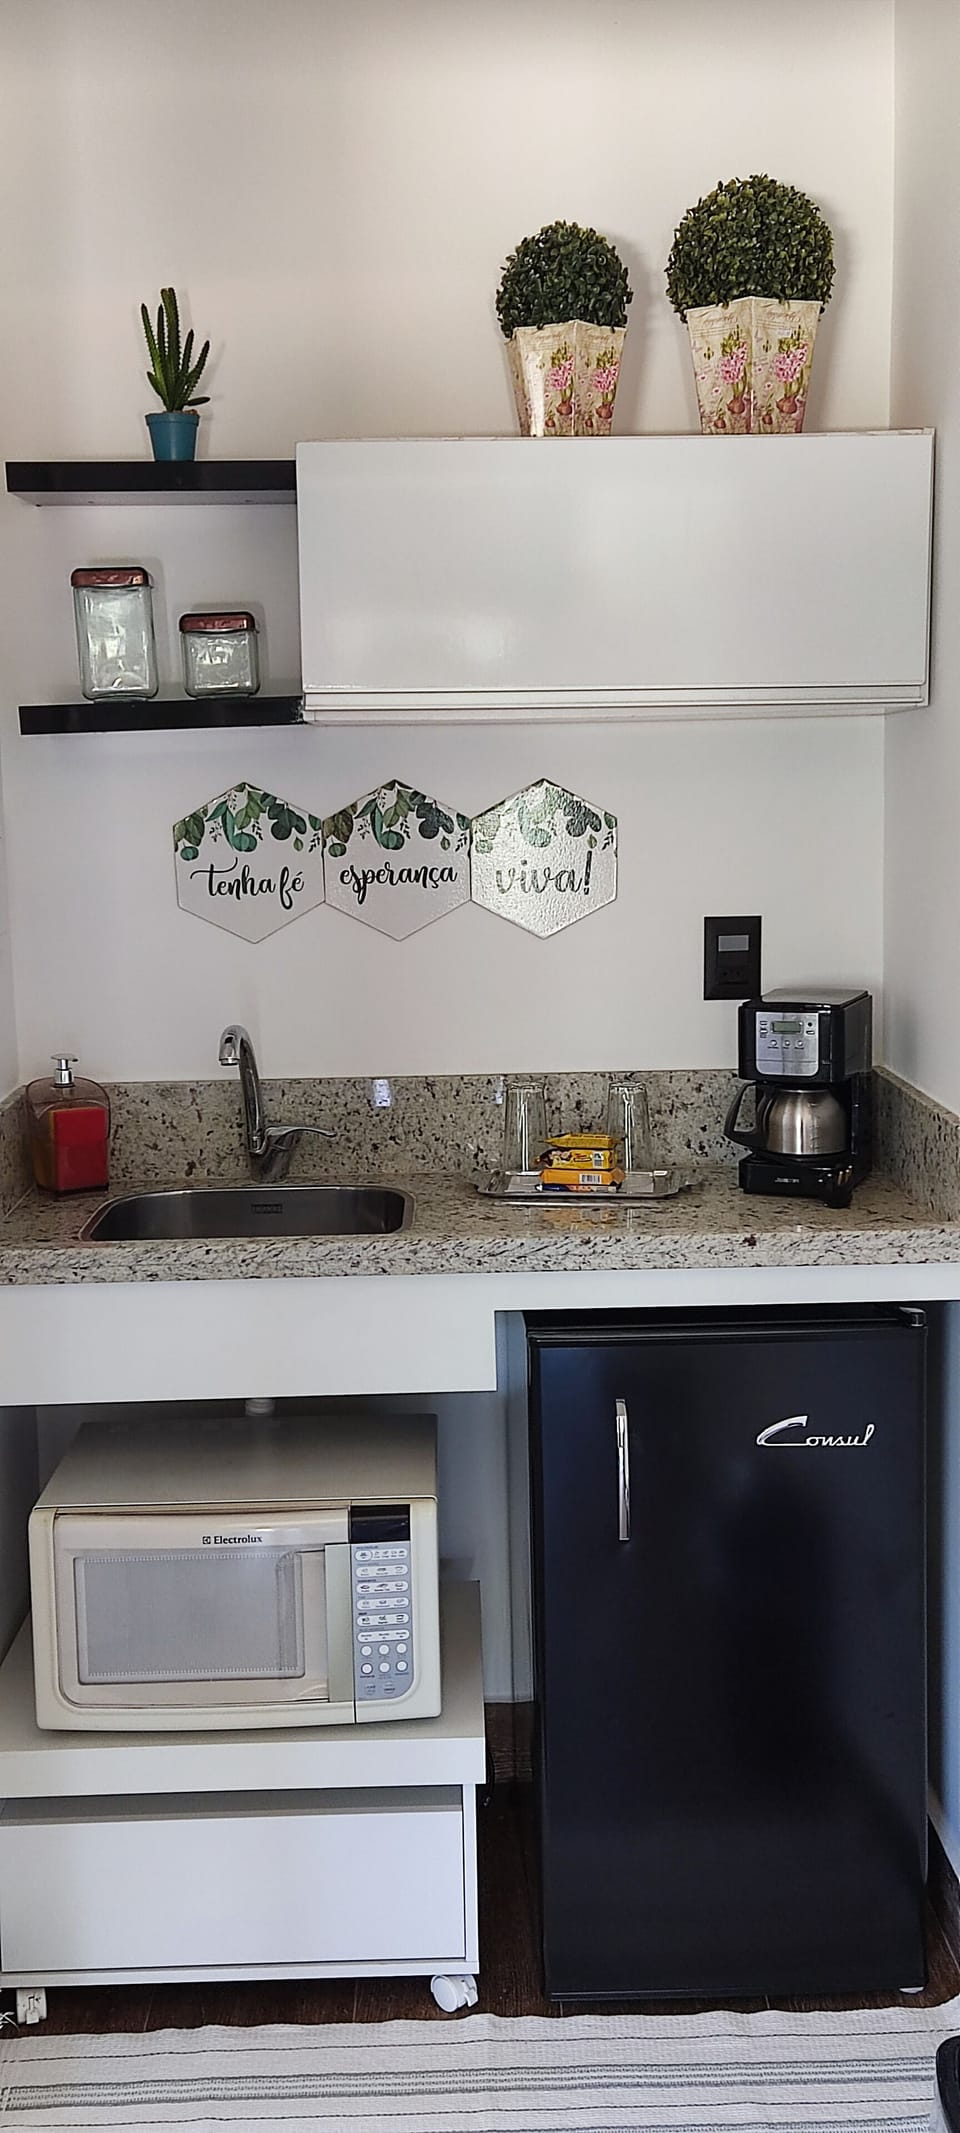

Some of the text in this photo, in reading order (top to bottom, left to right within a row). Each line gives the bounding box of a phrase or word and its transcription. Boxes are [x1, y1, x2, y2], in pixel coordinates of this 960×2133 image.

[190, 857, 304, 910] tenha fé
[339, 861, 458, 904] esperança
[496, 850, 592, 895] viva!
[756, 1415, 875, 1446] Consul
[213, 1534, 263, 1545] Electrolux
